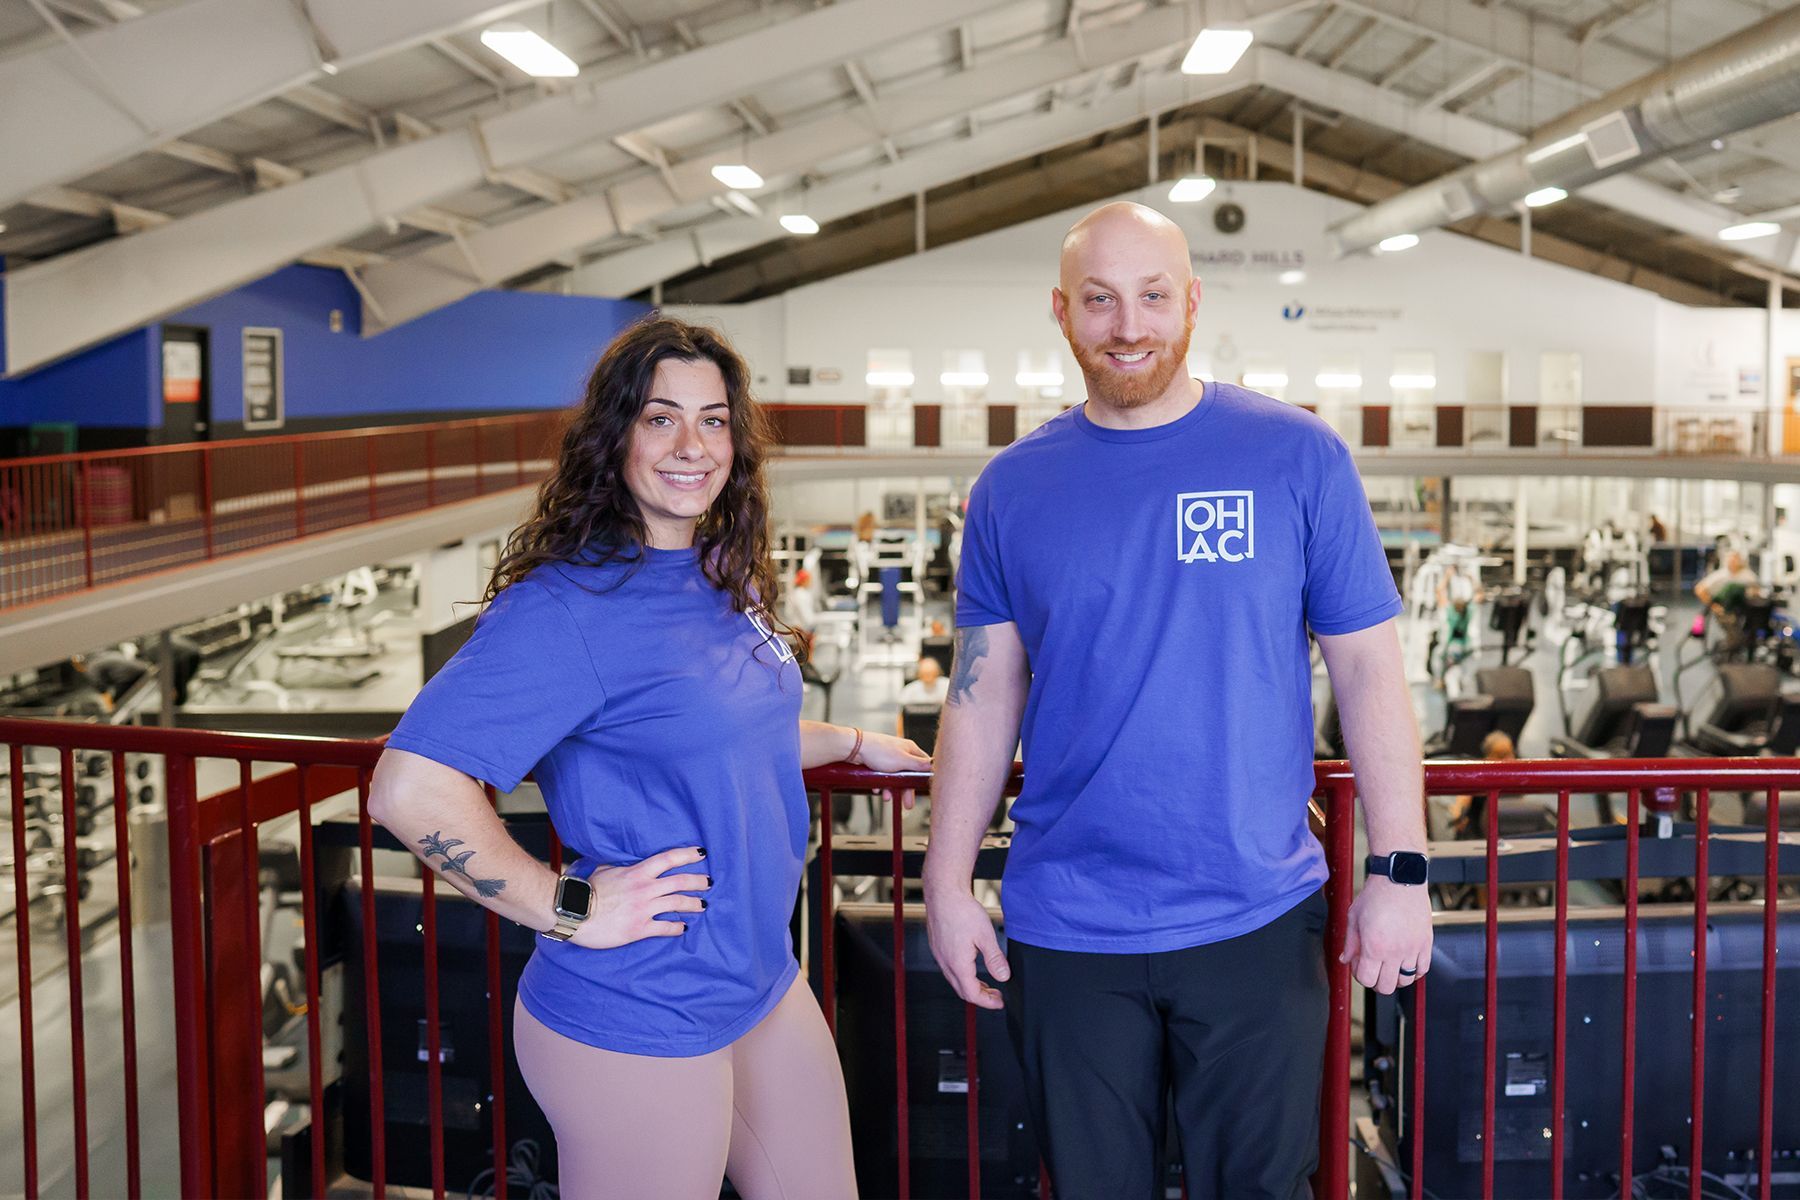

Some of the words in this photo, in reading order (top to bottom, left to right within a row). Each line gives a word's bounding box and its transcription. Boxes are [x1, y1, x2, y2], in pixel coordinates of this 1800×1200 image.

[1251, 250, 1304, 267] HILLS
[1184, 499, 1245, 532] OH
[1184, 530, 1245, 563] AC
